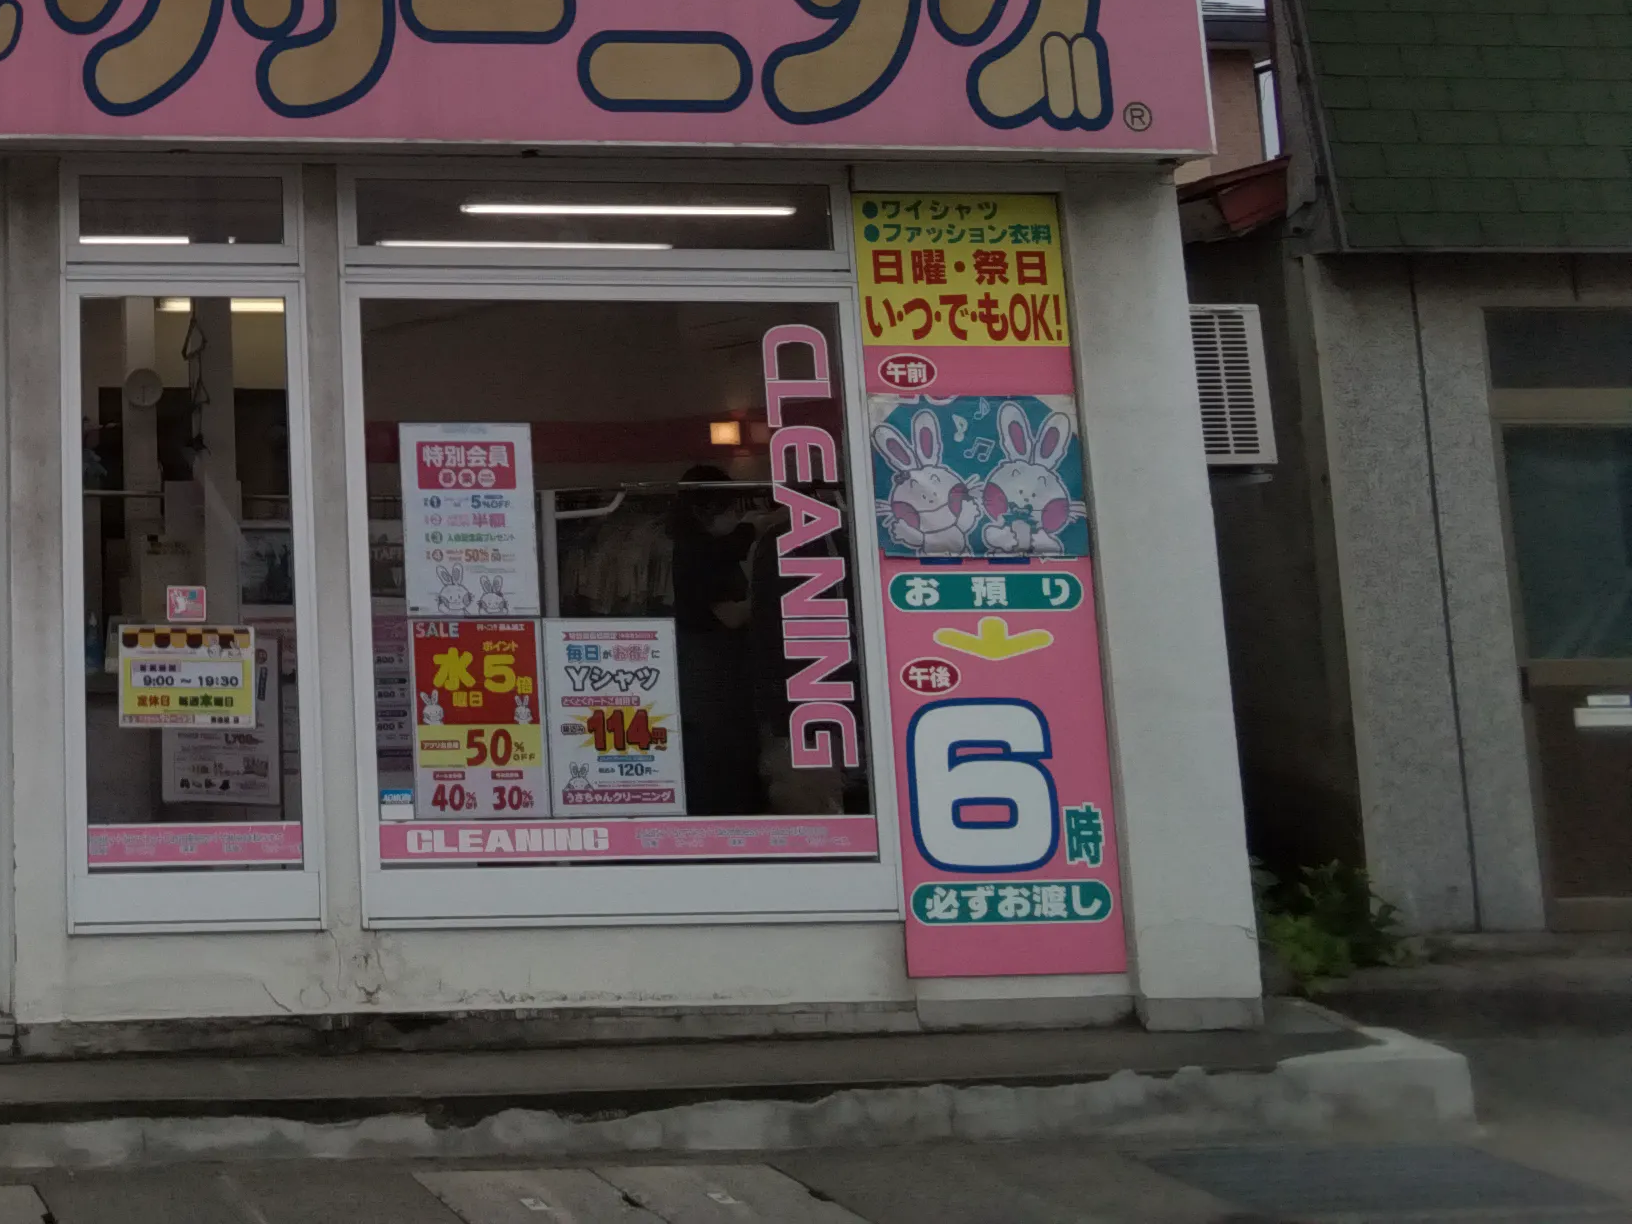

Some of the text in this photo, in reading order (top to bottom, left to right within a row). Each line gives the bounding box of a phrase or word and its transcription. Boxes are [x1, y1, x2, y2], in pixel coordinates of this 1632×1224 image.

[881, 200, 998, 221] ワイシャツ
[883, 223, 1053, 245] ファッション衣料
[872, 249, 1048, 286] 日曜・祭日
[886, 362, 928, 384] 午前
[422, 445, 509, 468] 特別会員
[762, 323, 860, 768] CLEANING
[904, 576, 1071, 607] お預り
[415, 622, 459, 638] SALE
[482, 640, 518, 652] ポイント
[564, 666, 660, 691] Yシャツ
[909, 665, 951, 689] 午後
[567, 789, 671, 803] うさちゃんクリーニング
[406, 827, 609, 853] CLEANING
[925, 885, 1102, 919] 必ずお渡し
